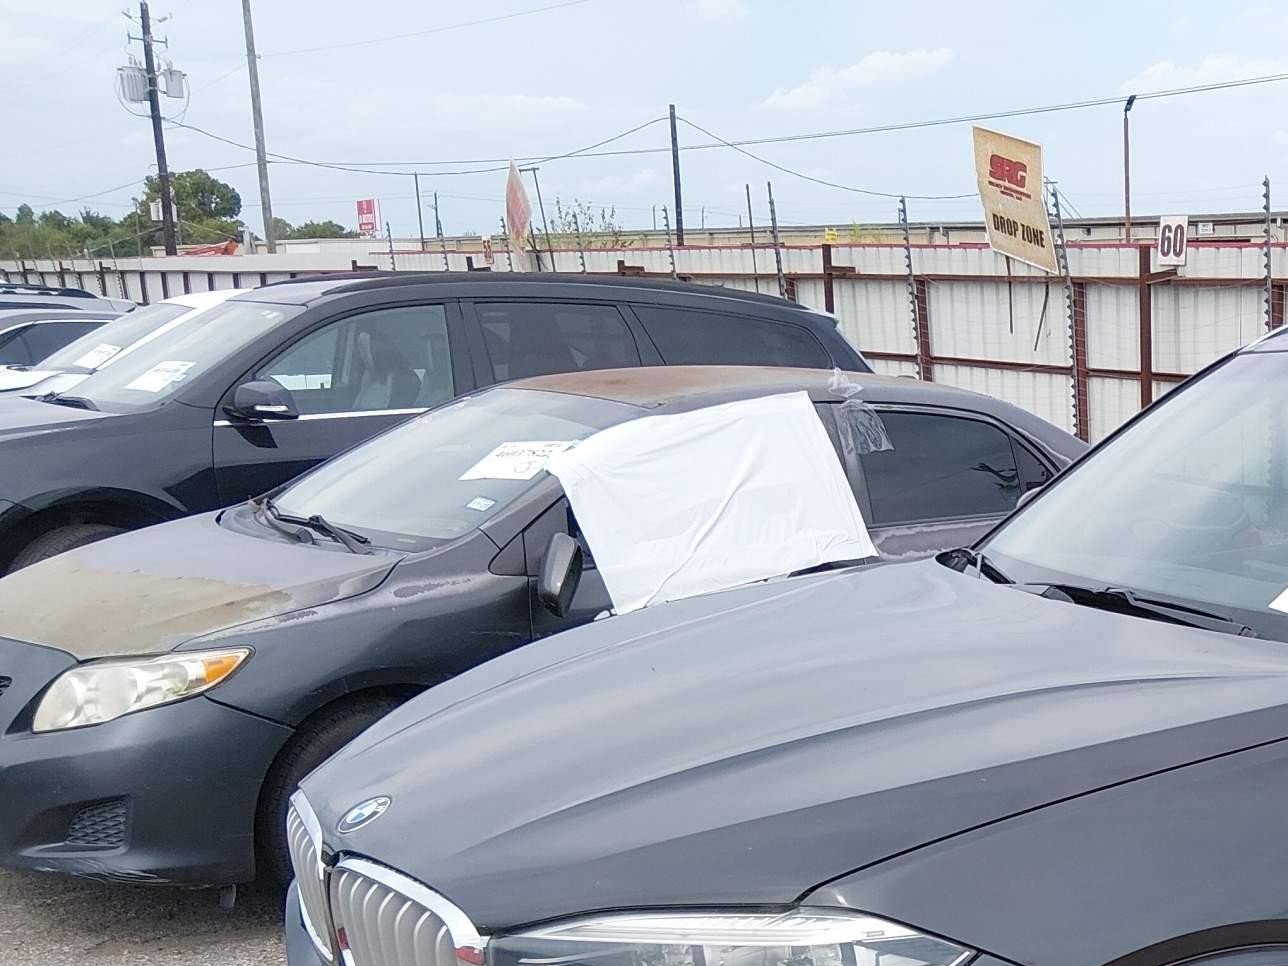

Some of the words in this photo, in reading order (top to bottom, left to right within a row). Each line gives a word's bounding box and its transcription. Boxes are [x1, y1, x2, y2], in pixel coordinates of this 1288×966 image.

[988, 153, 1028, 189] SRG
[992, 212, 1019, 236] DROP
[1021, 224, 1046, 249] ZONE
[1159, 223, 1185, 258] 60
